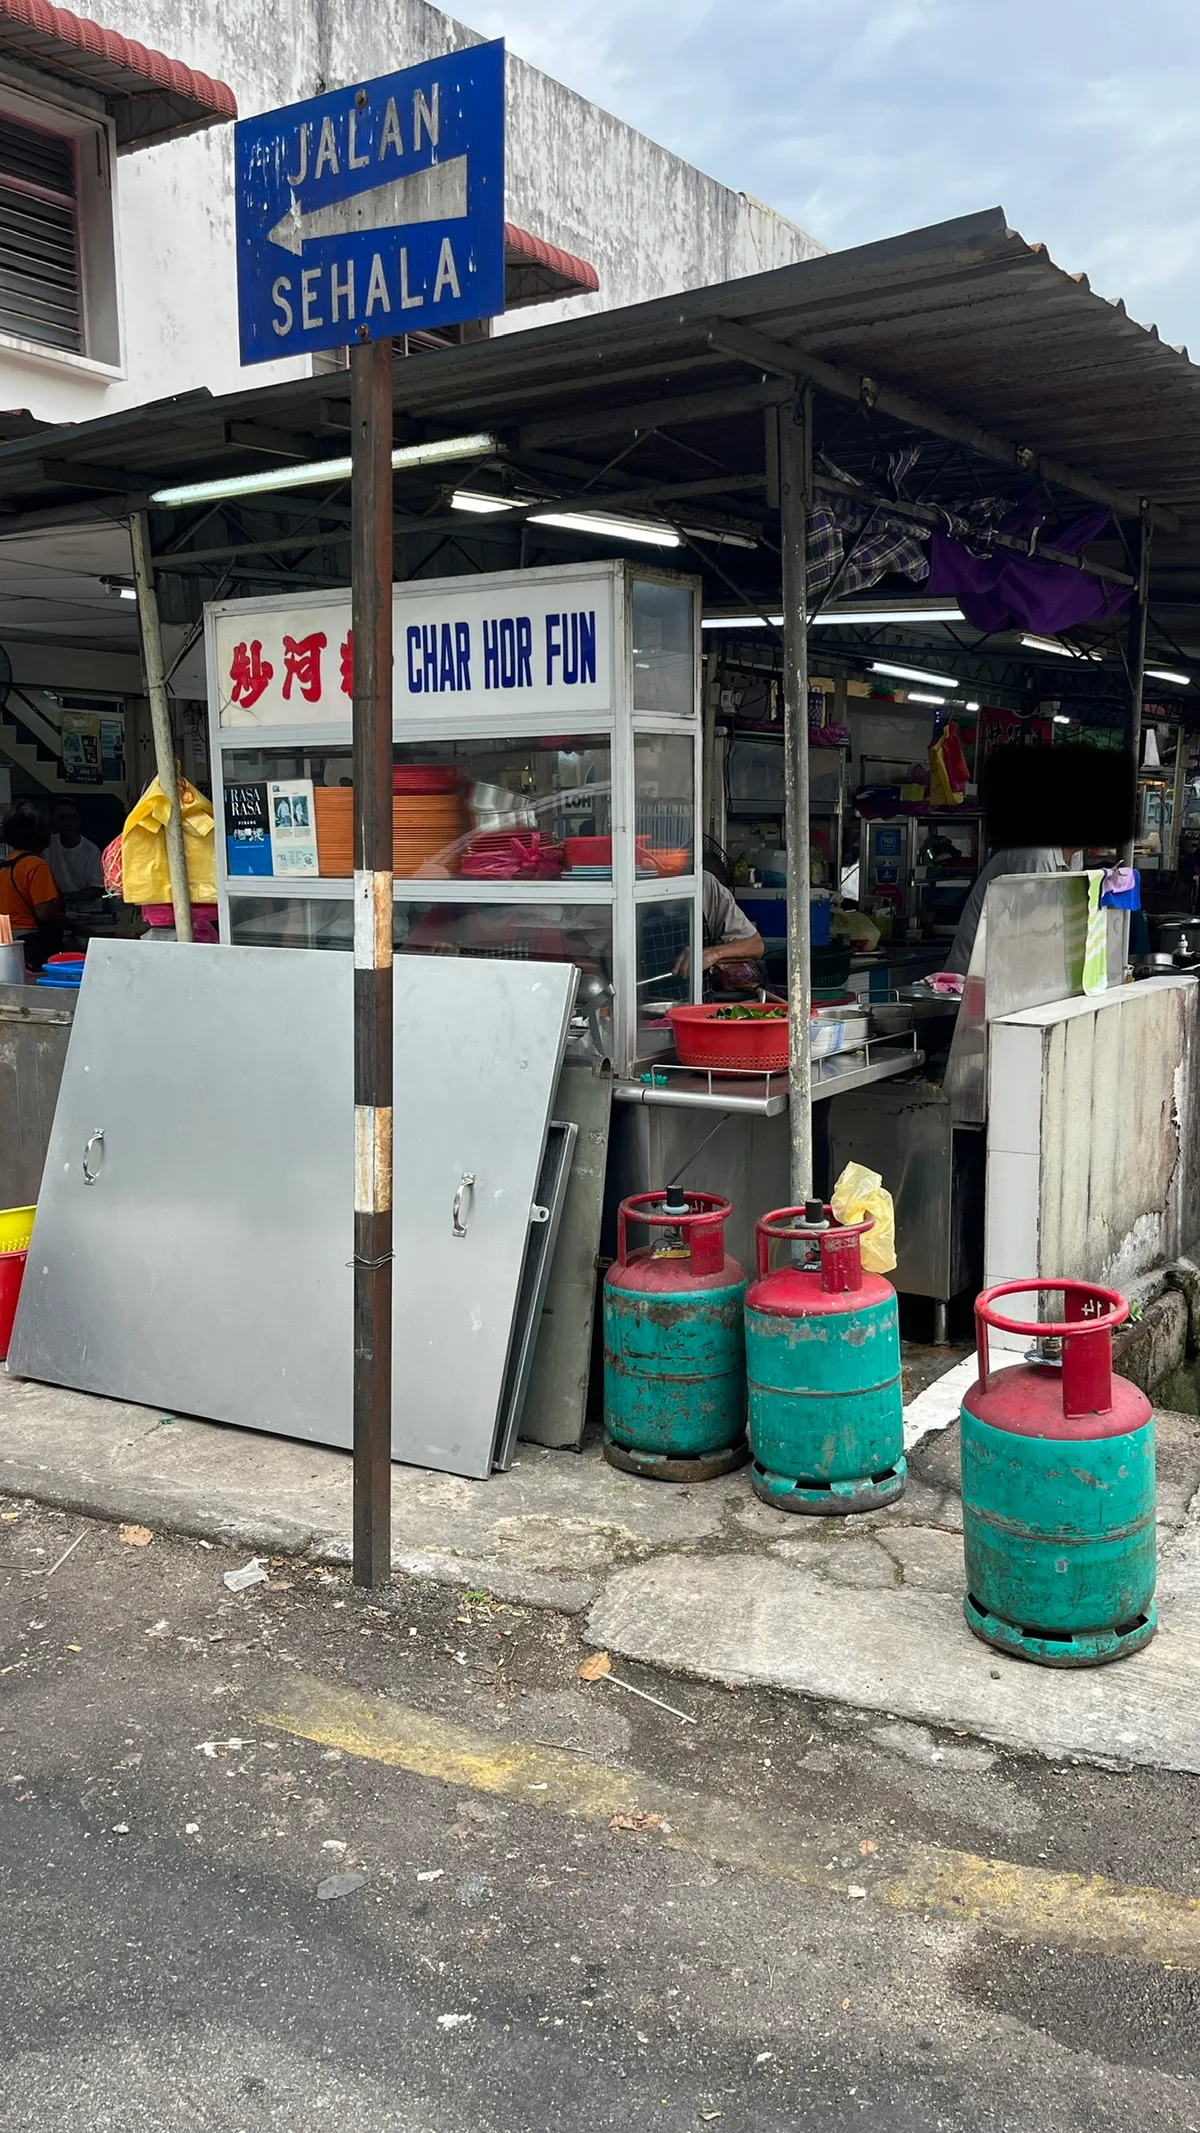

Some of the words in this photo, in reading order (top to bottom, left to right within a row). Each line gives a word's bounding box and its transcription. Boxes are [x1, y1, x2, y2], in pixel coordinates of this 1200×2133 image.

[288, 83, 440, 186] JALAN
[272, 237, 461, 337] SEHALA
[229, 629, 353, 709] 炒河
[406, 621, 471, 694] CHAR
[483, 616, 532, 690] HOR
[545, 610, 597, 686] FUN
[230, 787, 261, 802] RASA
[231, 801, 262, 816] RASA
